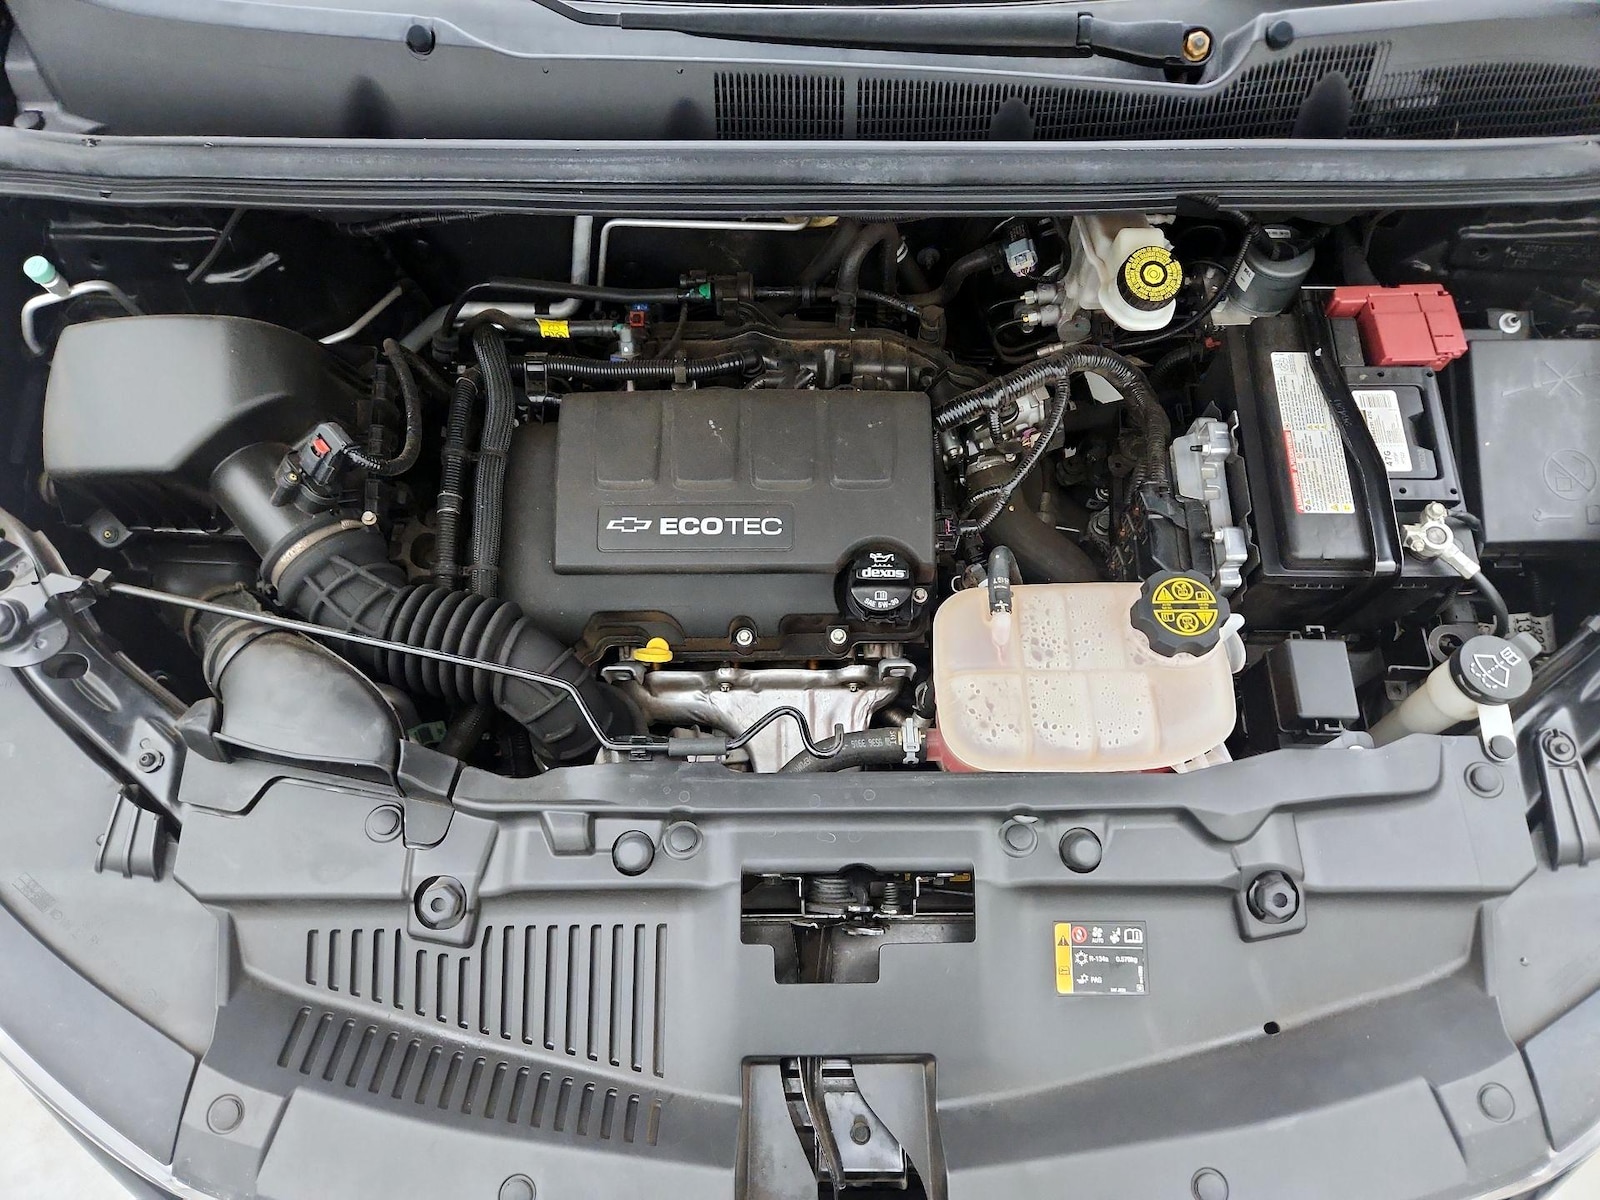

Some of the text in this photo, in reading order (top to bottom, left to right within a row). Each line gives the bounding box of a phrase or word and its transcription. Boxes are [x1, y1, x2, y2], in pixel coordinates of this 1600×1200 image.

[1383, 450, 1393, 467] 47G
[660, 517, 783, 536] ECOTEC
[861, 567, 907, 578] dexos
[863, 597, 876, 608] SAE
